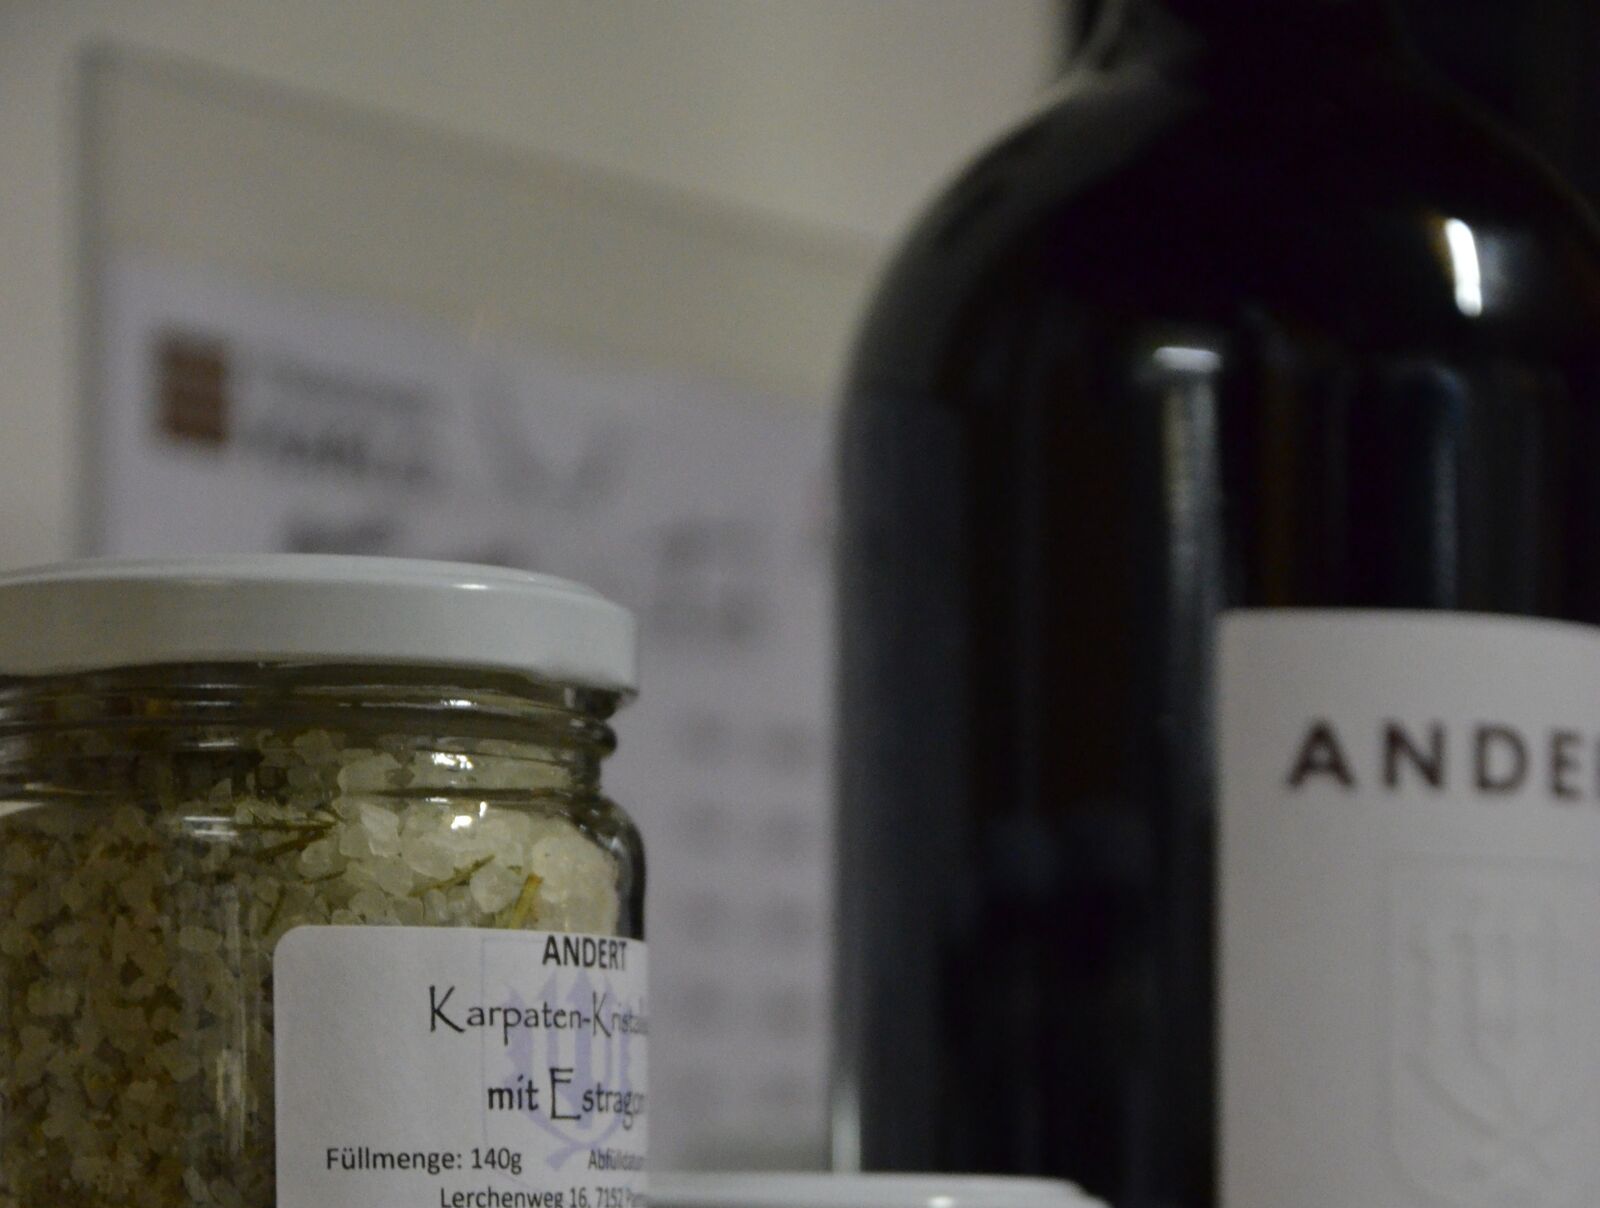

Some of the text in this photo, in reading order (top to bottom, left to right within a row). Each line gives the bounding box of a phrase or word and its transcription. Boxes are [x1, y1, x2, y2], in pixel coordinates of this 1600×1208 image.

[1287, 716, 1600, 804] ANDE
[542, 935, 627, 971] ANDERT
[487, 1073, 539, 1112] mit
[326, 1147, 462, 1175] Füllmenge:
[470, 1147, 522, 1175] 140g
